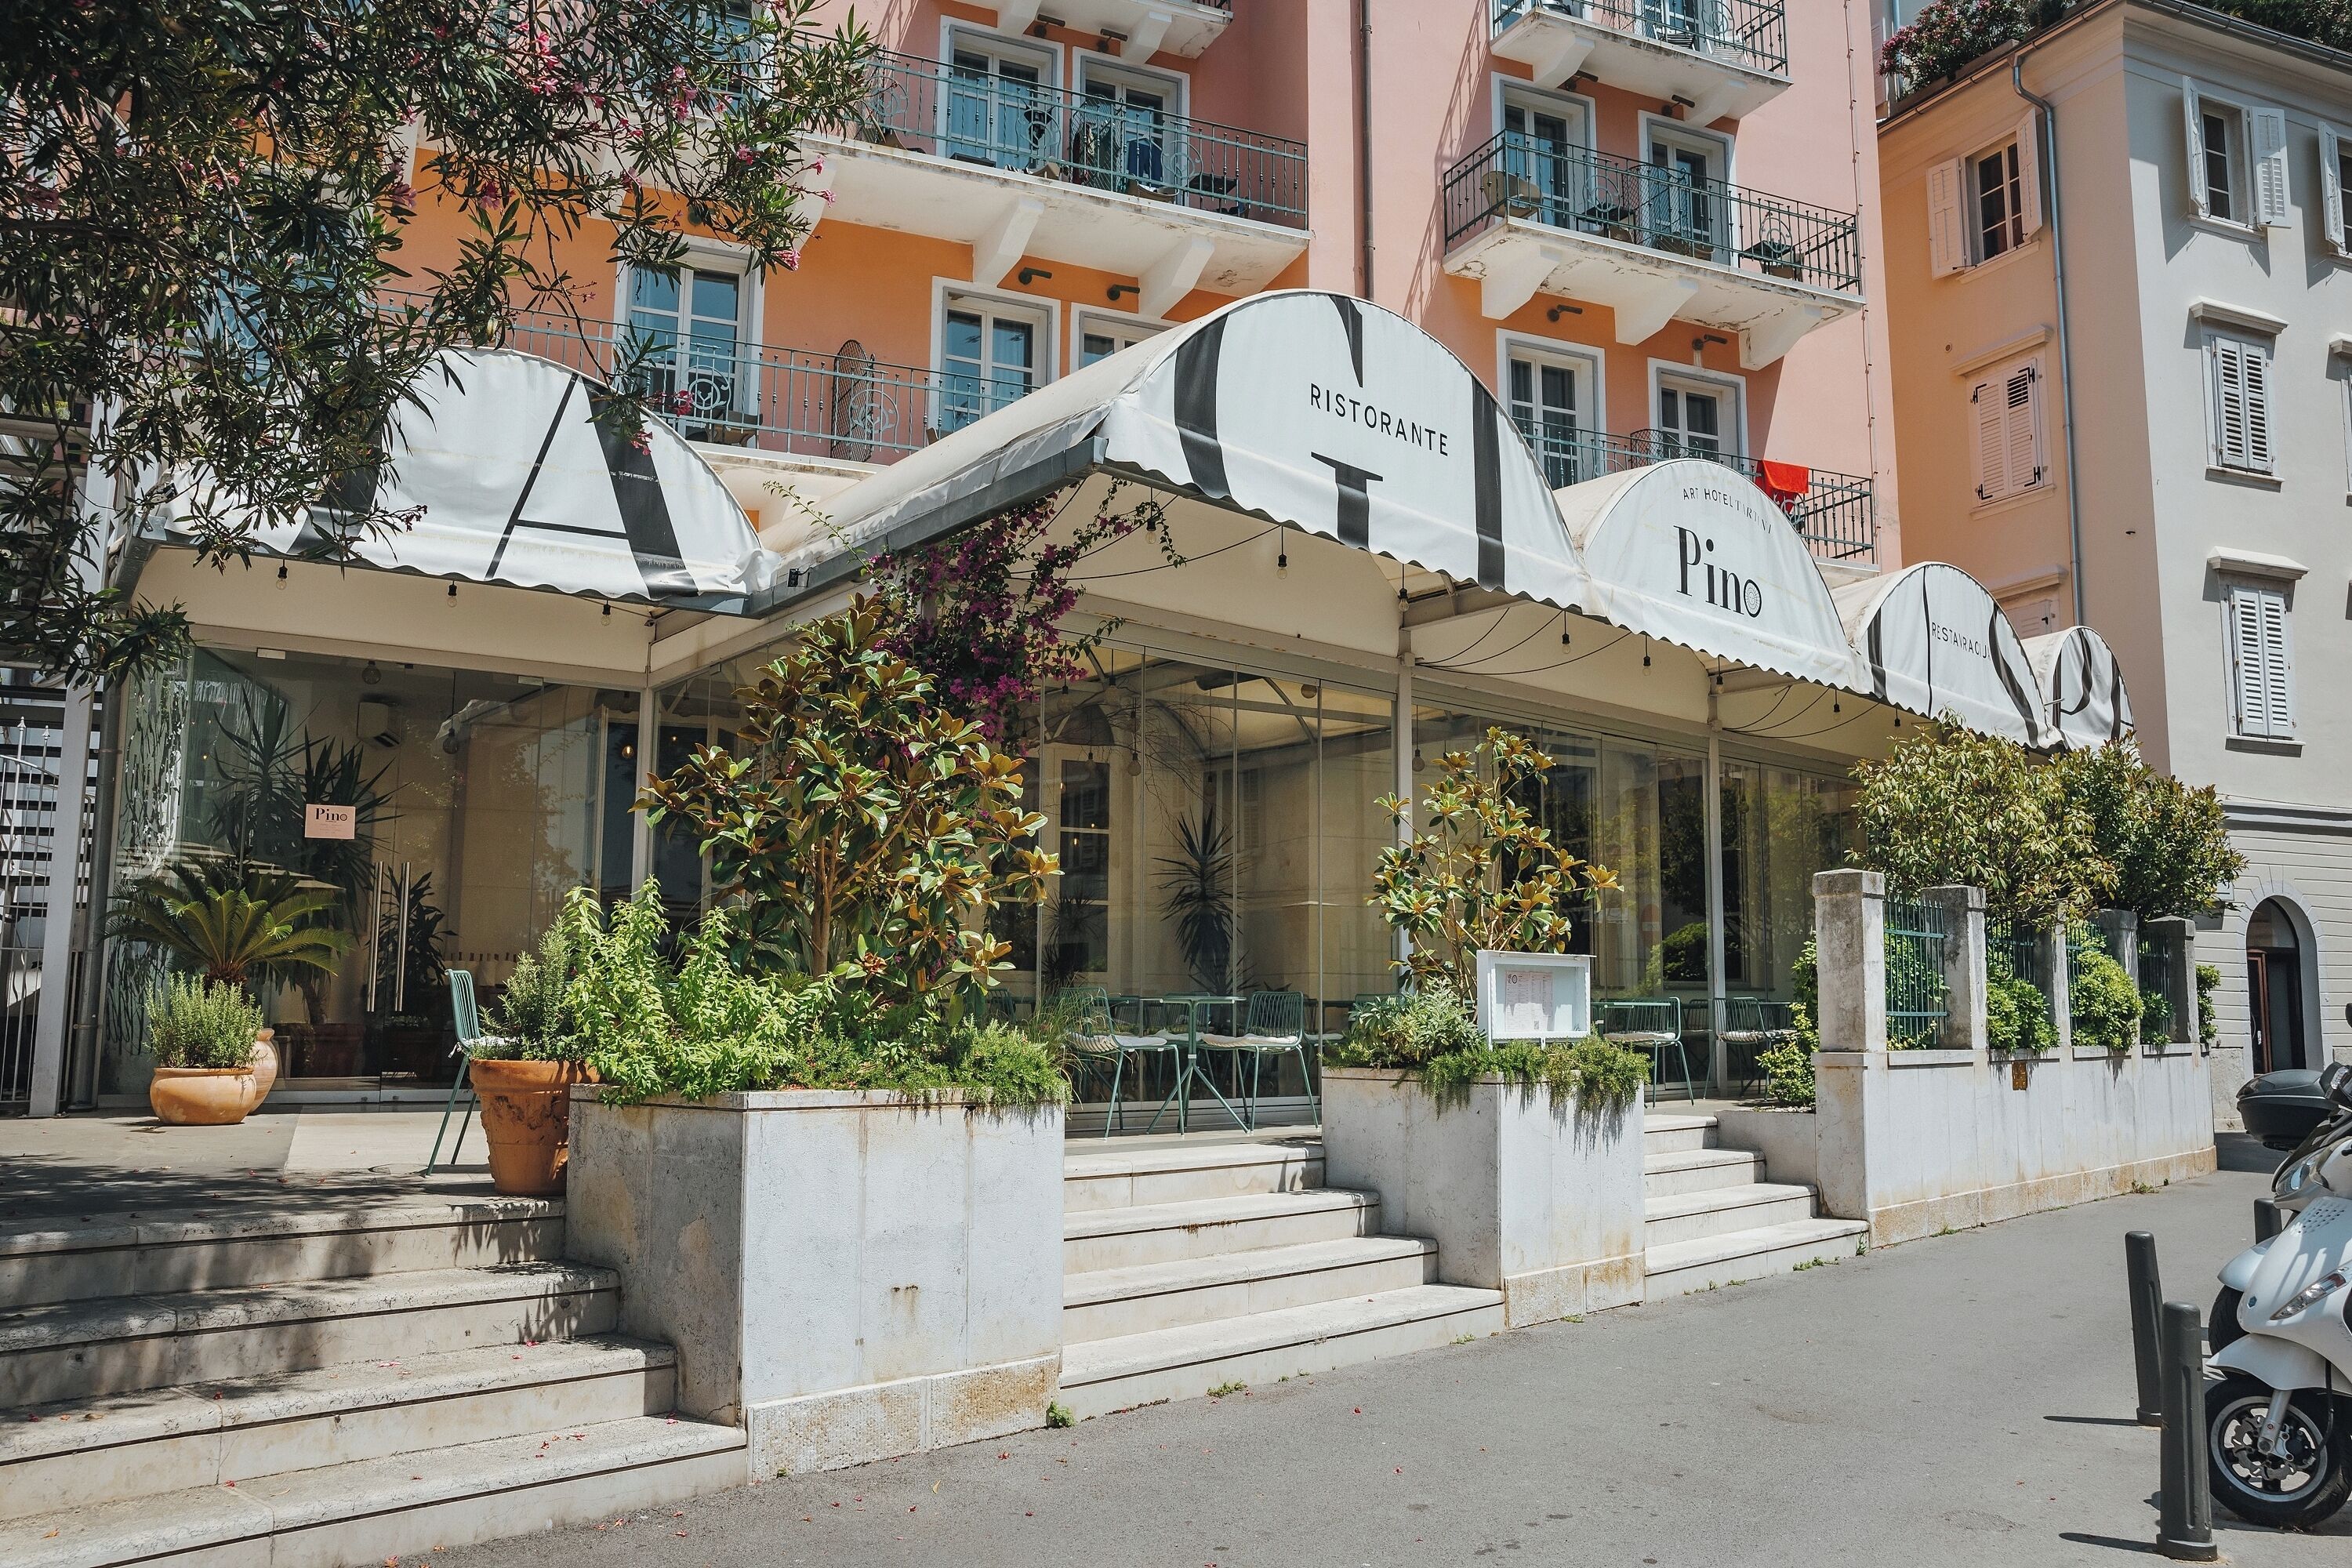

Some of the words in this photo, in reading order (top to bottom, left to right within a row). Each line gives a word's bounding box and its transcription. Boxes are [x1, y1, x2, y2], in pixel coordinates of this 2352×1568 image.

[1310, 383, 1449, 457] RISTORANTE
[1682, 487, 1700, 501] ART
[1704, 488, 1733, 508] HOTEL
[1673, 525, 1762, 618] Pino
[316, 808, 347, 821] Pino
